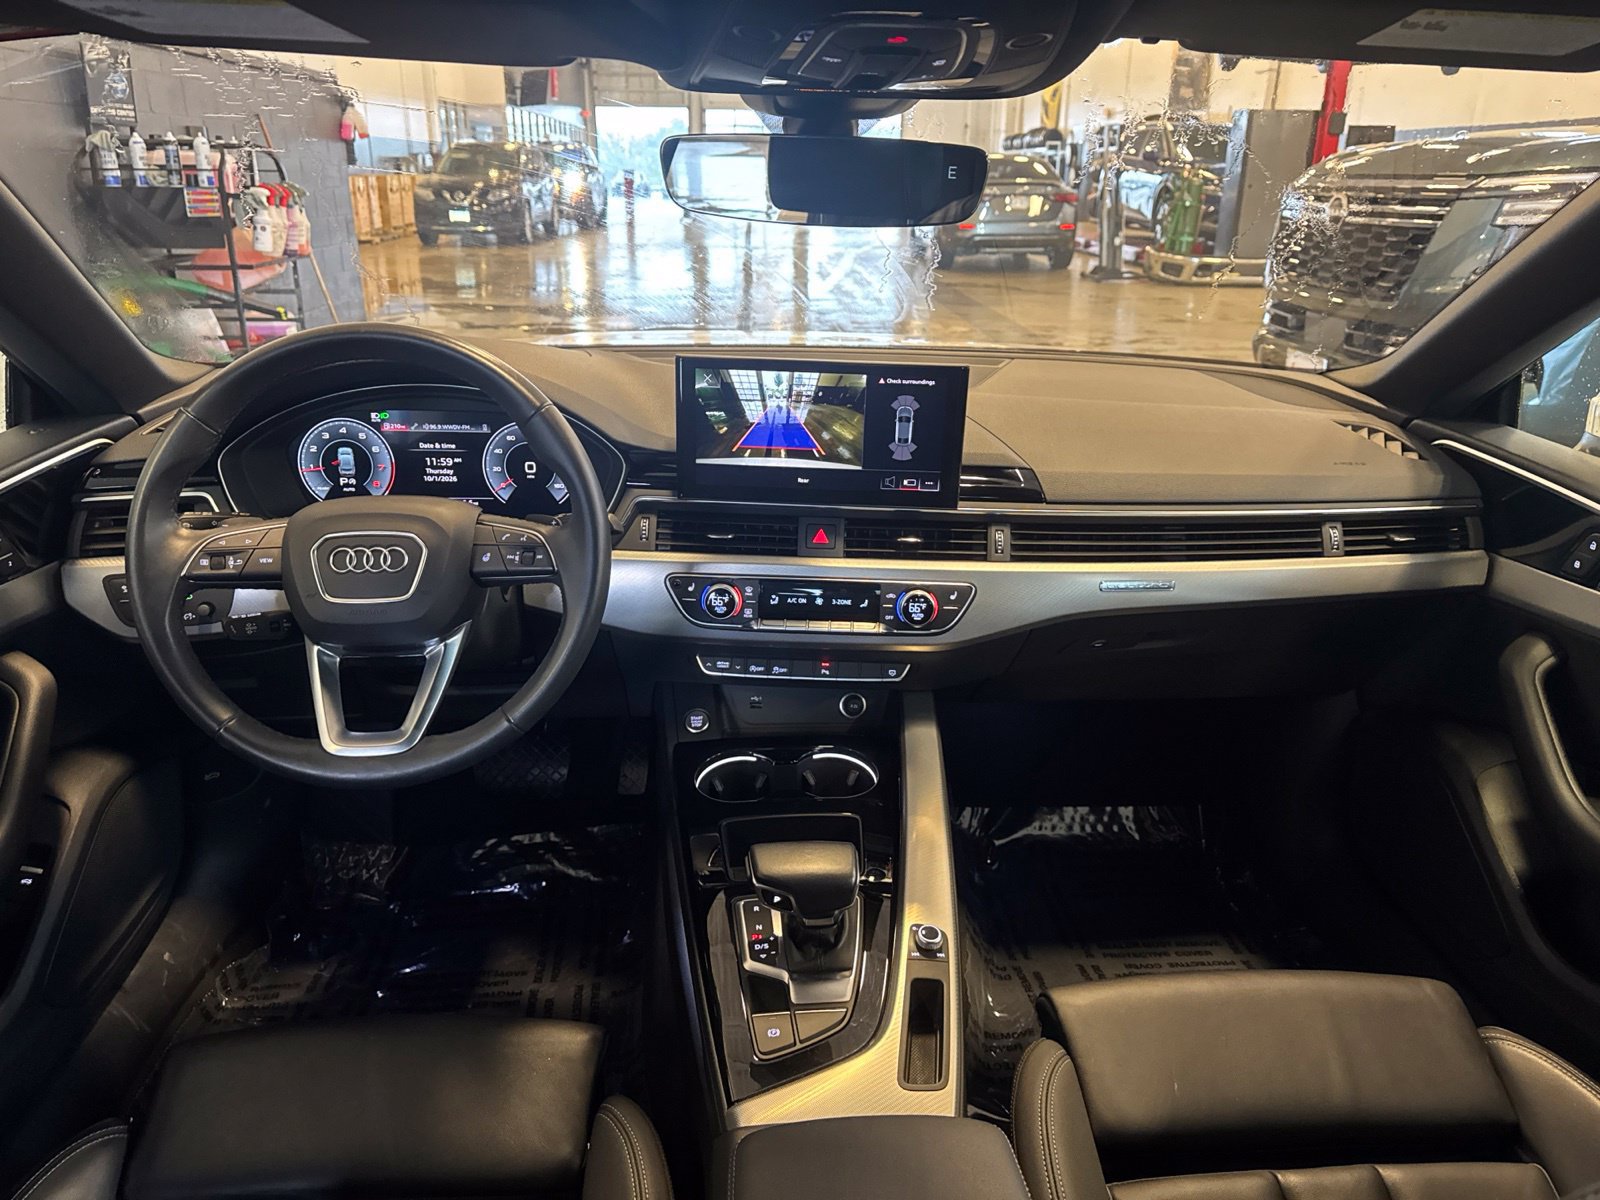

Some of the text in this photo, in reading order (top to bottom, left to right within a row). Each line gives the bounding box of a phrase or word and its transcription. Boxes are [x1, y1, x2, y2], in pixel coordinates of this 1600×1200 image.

[948, 166, 957, 179] E
[902, 378, 936, 386] surroundings
[338, 426, 347, 434] 4
[371, 445, 380, 453] 6
[425, 457, 453, 466] 11:59
[424, 467, 454, 475] Thursday
[524, 461, 536, 473] 0
[831, 598, 852, 606] 3-ZONE
